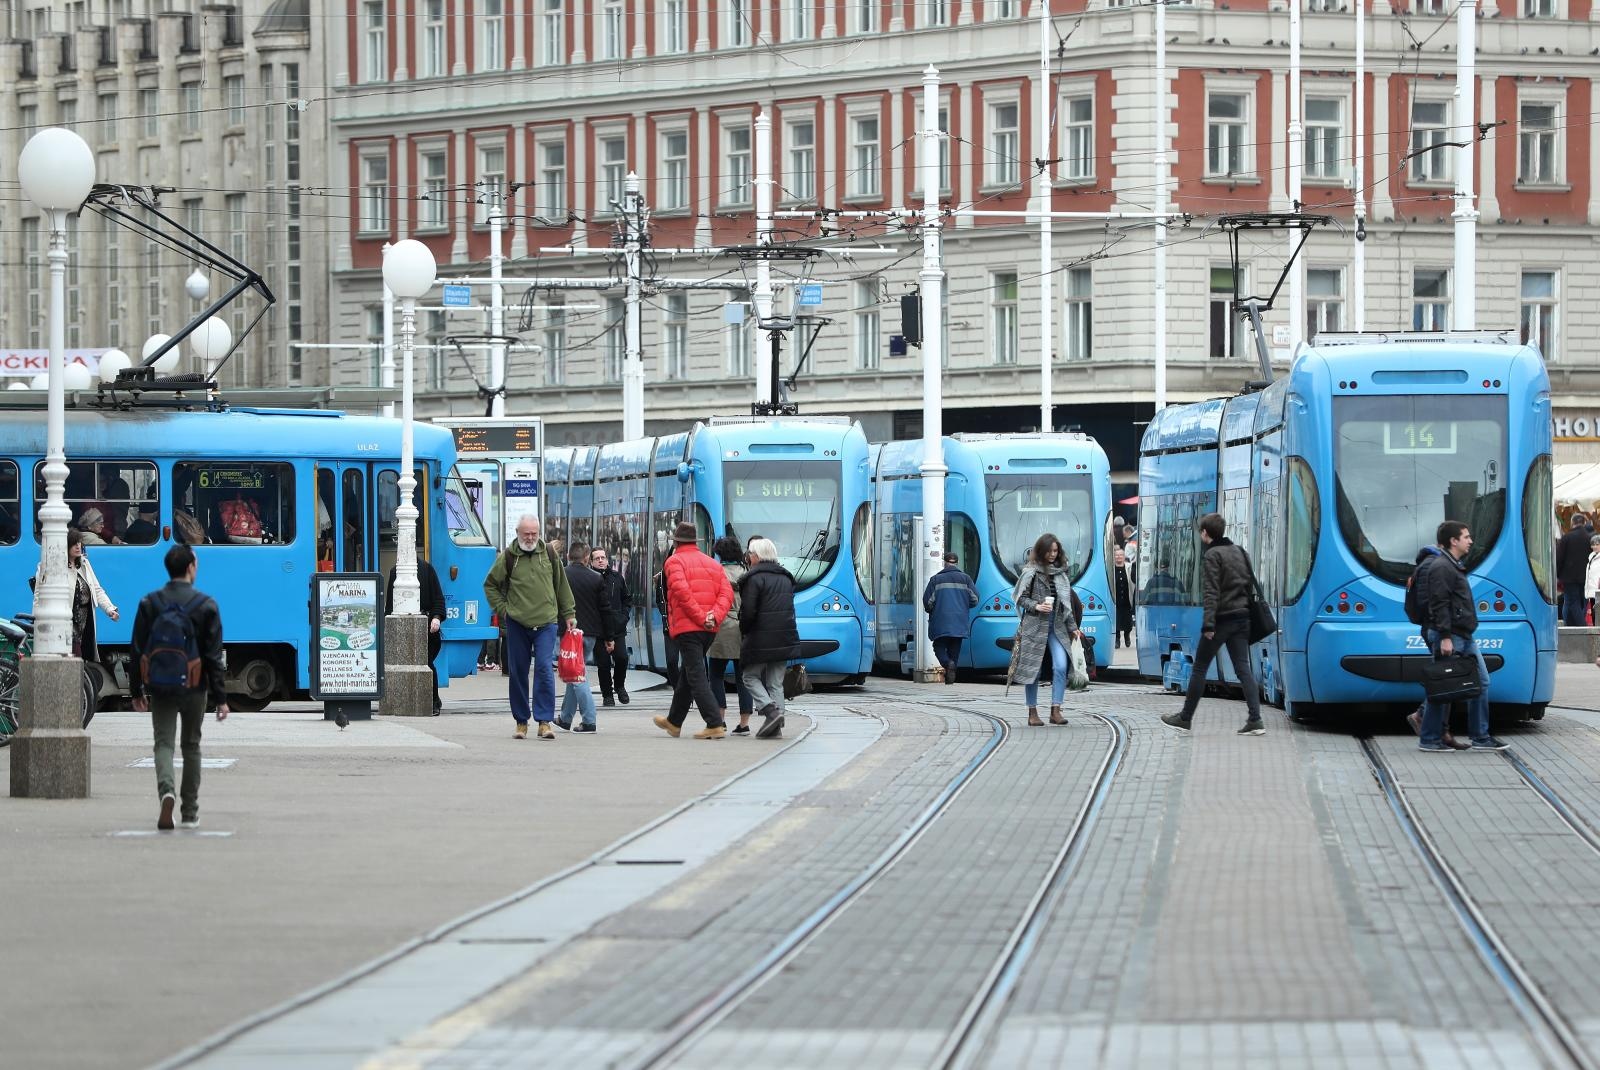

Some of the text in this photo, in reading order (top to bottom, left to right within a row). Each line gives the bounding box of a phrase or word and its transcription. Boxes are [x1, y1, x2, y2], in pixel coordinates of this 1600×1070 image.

[1404, 423, 1434, 447] 14
[357, 443, 379, 451] ULAZ
[200, 471, 209, 487] 6
[736, 480, 744, 497] 6
[338, 589, 367, 597] MARINA
[1475, 638, 1504, 649] 2237
[320, 679, 377, 688] www.hotel-marina.hr
